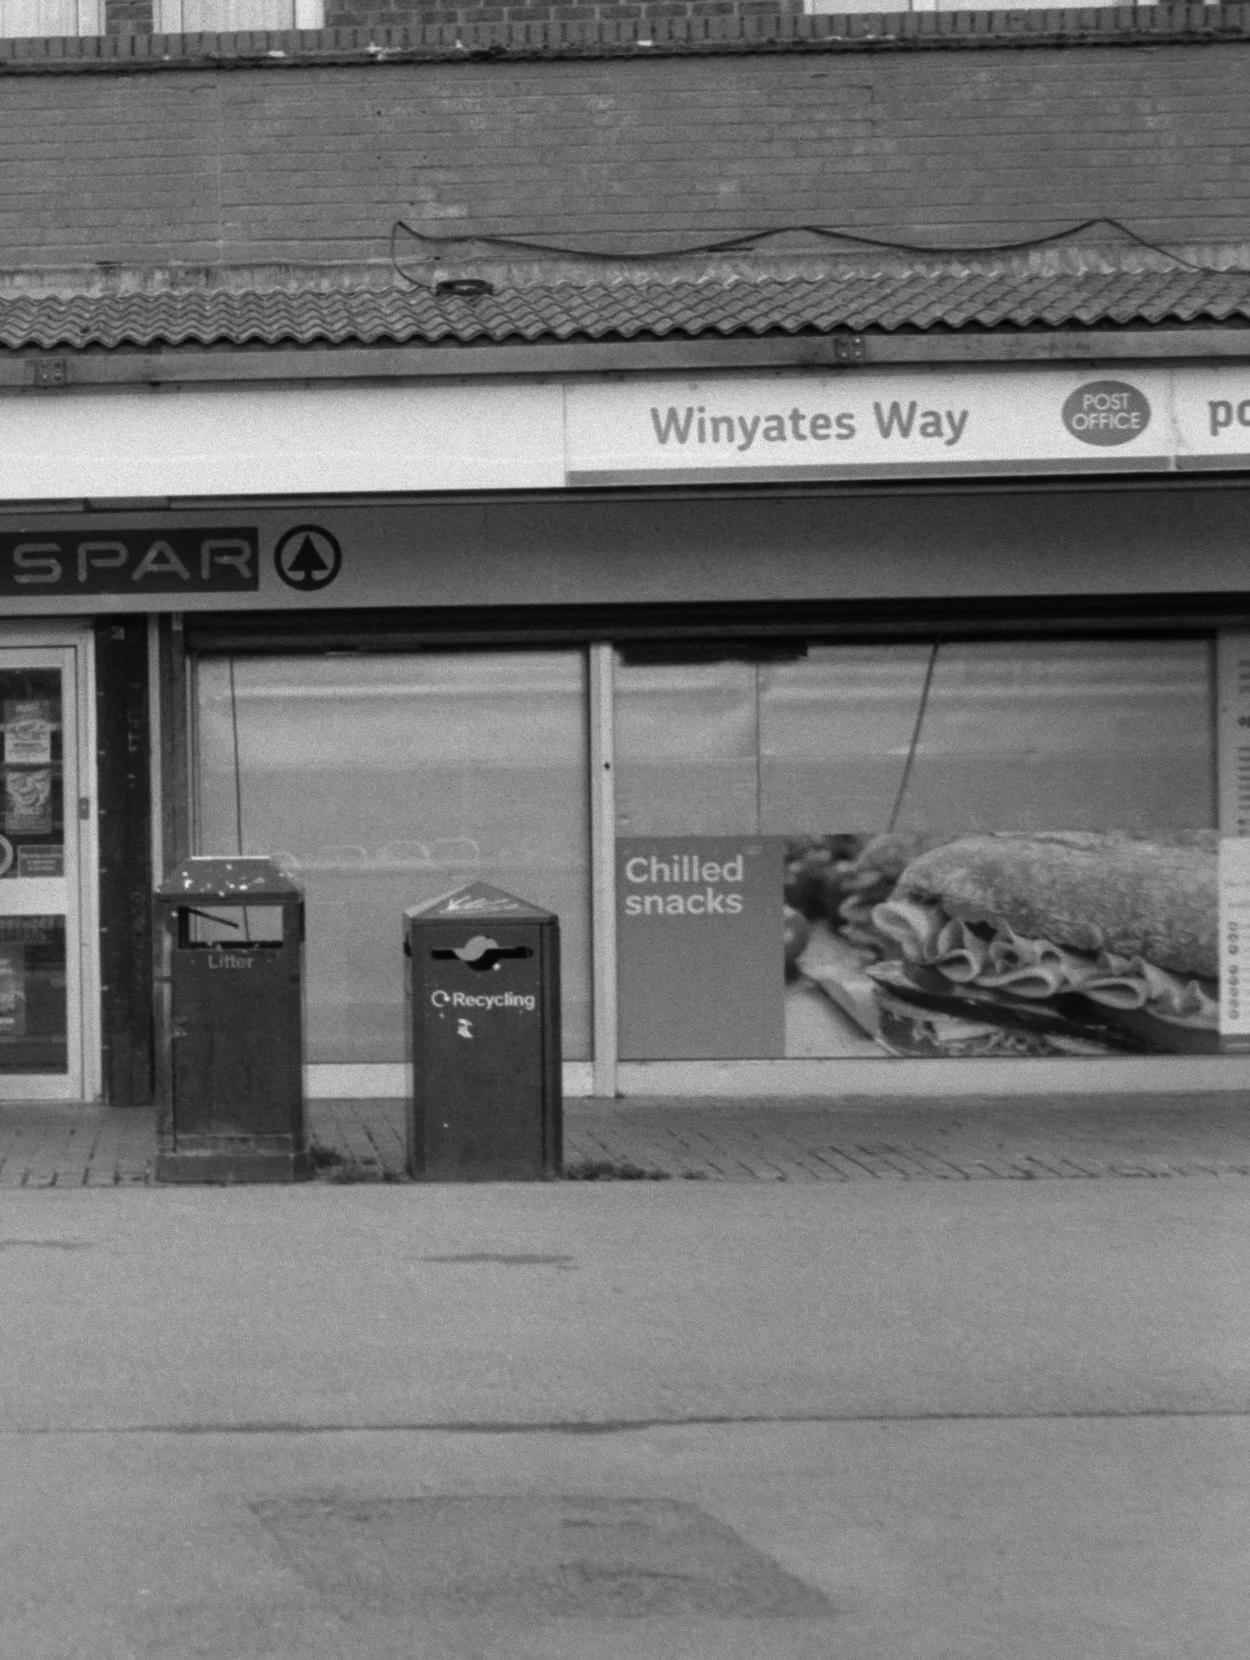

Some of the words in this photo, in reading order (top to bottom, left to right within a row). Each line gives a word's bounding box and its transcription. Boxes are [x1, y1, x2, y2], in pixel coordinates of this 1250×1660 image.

[1082, 392, 1131, 411] POST
[650, 405, 857, 452] Winyates
[872, 400, 969, 447] Way
[1071, 411, 1141, 431] OFFICE
[13, 538, 253, 585] SPAR
[626, 854, 744, 883] Chilled
[625, 887, 743, 915] snacks
[208, 954, 255, 969] Litter
[452, 991, 536, 1010] Recycling
